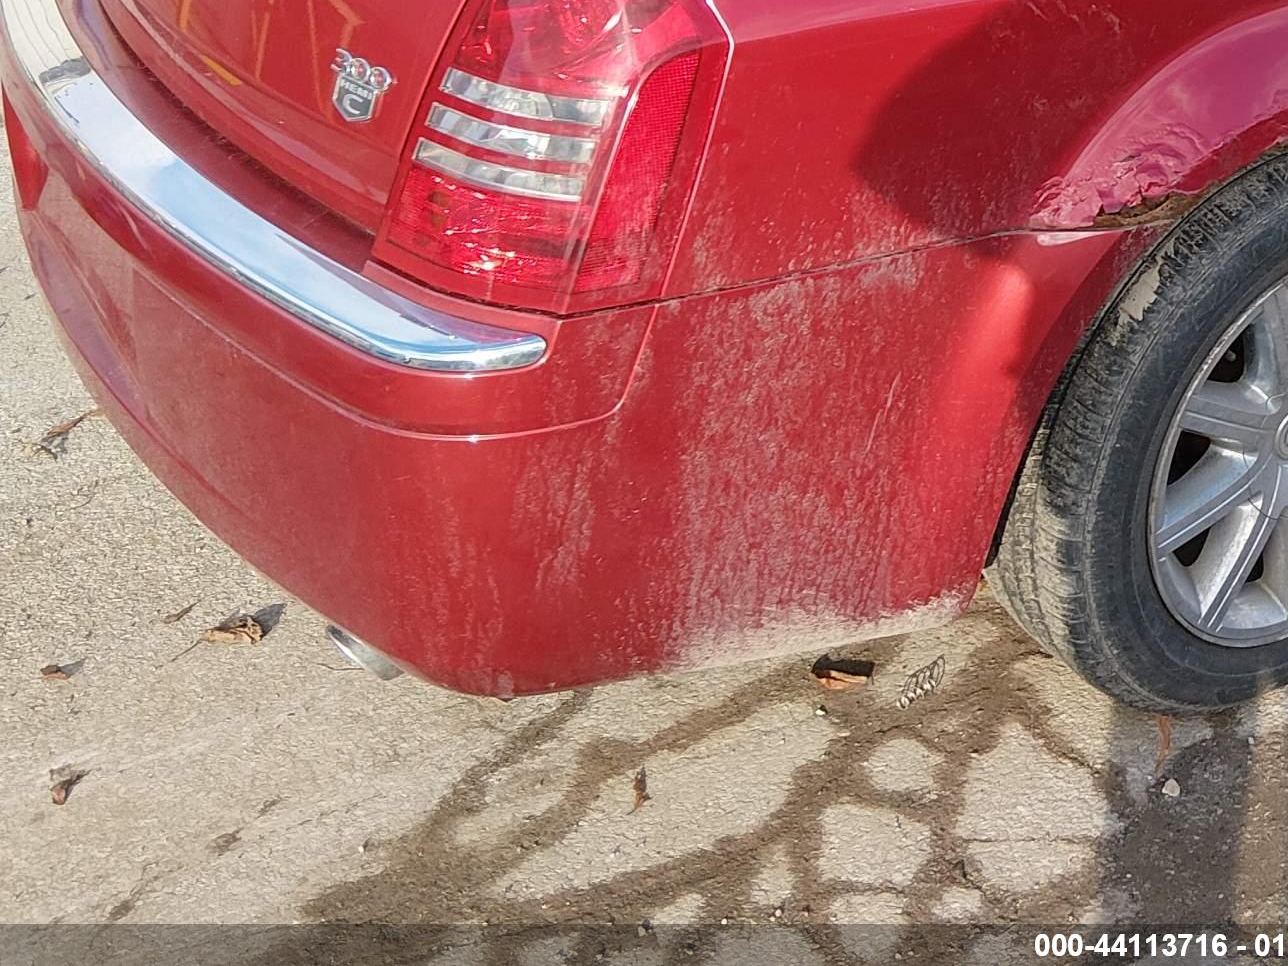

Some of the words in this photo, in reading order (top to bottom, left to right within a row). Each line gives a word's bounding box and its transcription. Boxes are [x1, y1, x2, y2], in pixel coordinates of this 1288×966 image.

[330, 47, 392, 91] 300
[340, 79, 373, 100] HEMI
[342, 93, 364, 115] C
